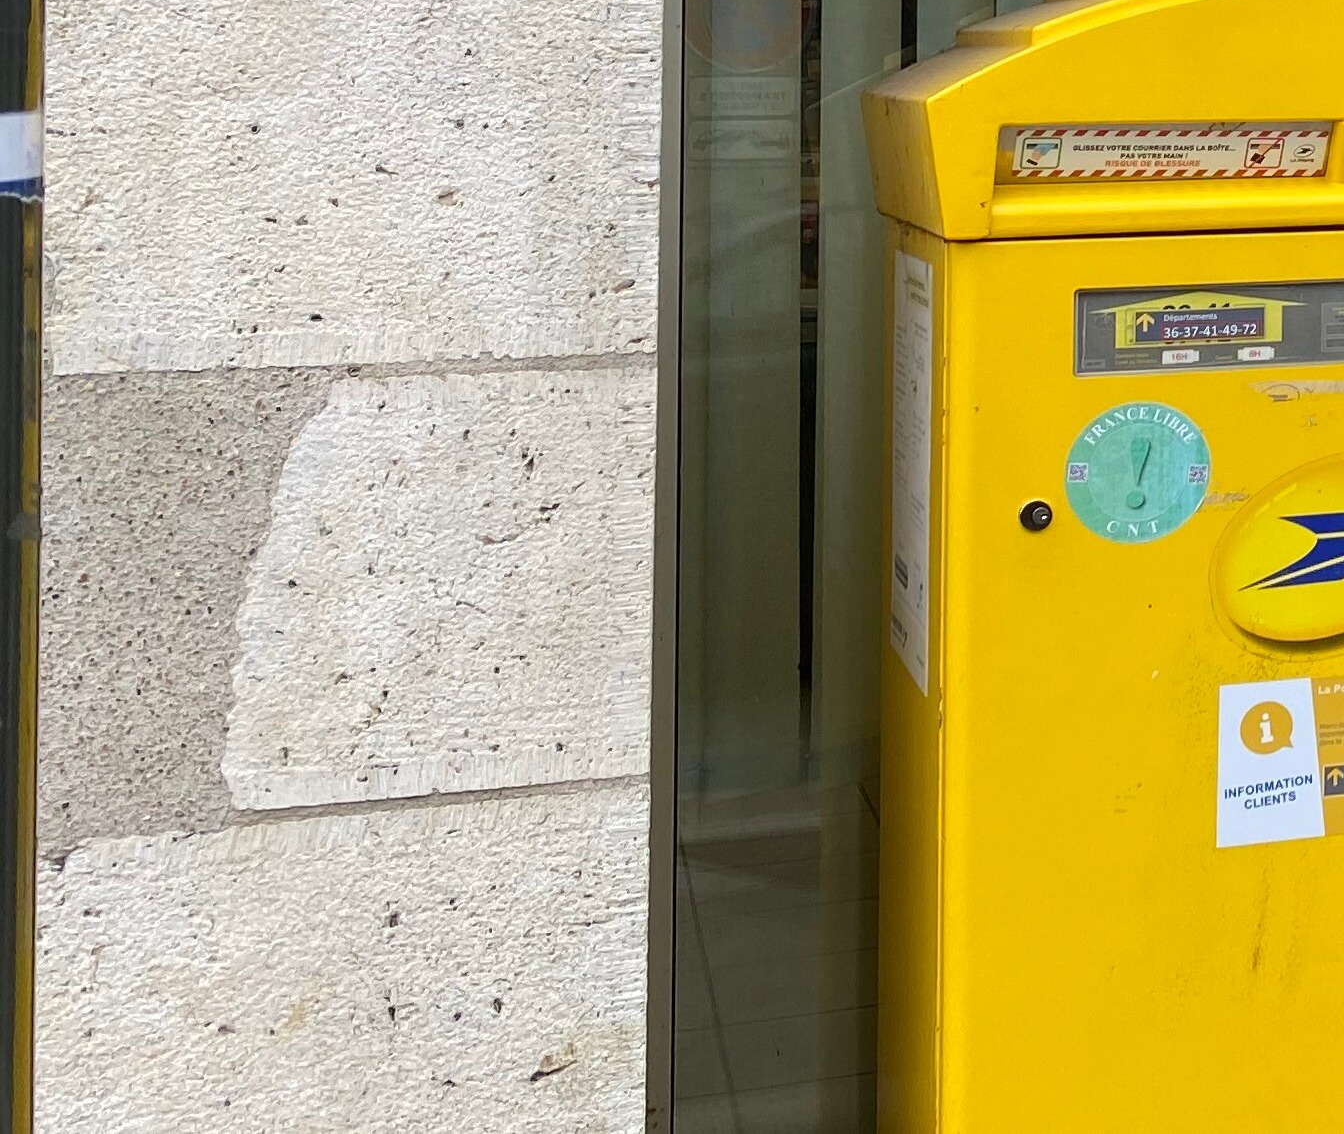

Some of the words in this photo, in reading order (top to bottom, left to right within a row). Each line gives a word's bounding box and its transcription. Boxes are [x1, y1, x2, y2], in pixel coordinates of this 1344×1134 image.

[1163, 313, 1218, 323] Départements
[1163, 323, 1257, 339] 36-37-41-49-72
[1083, 406, 1149, 446] FRANCE
[1153, 408, 1197, 445] LIBRE
[1318, 685, 1330, 695] La
[1224, 773, 1313, 799] INFORMATION
[1244, 791, 1297, 809] CLIENTS
